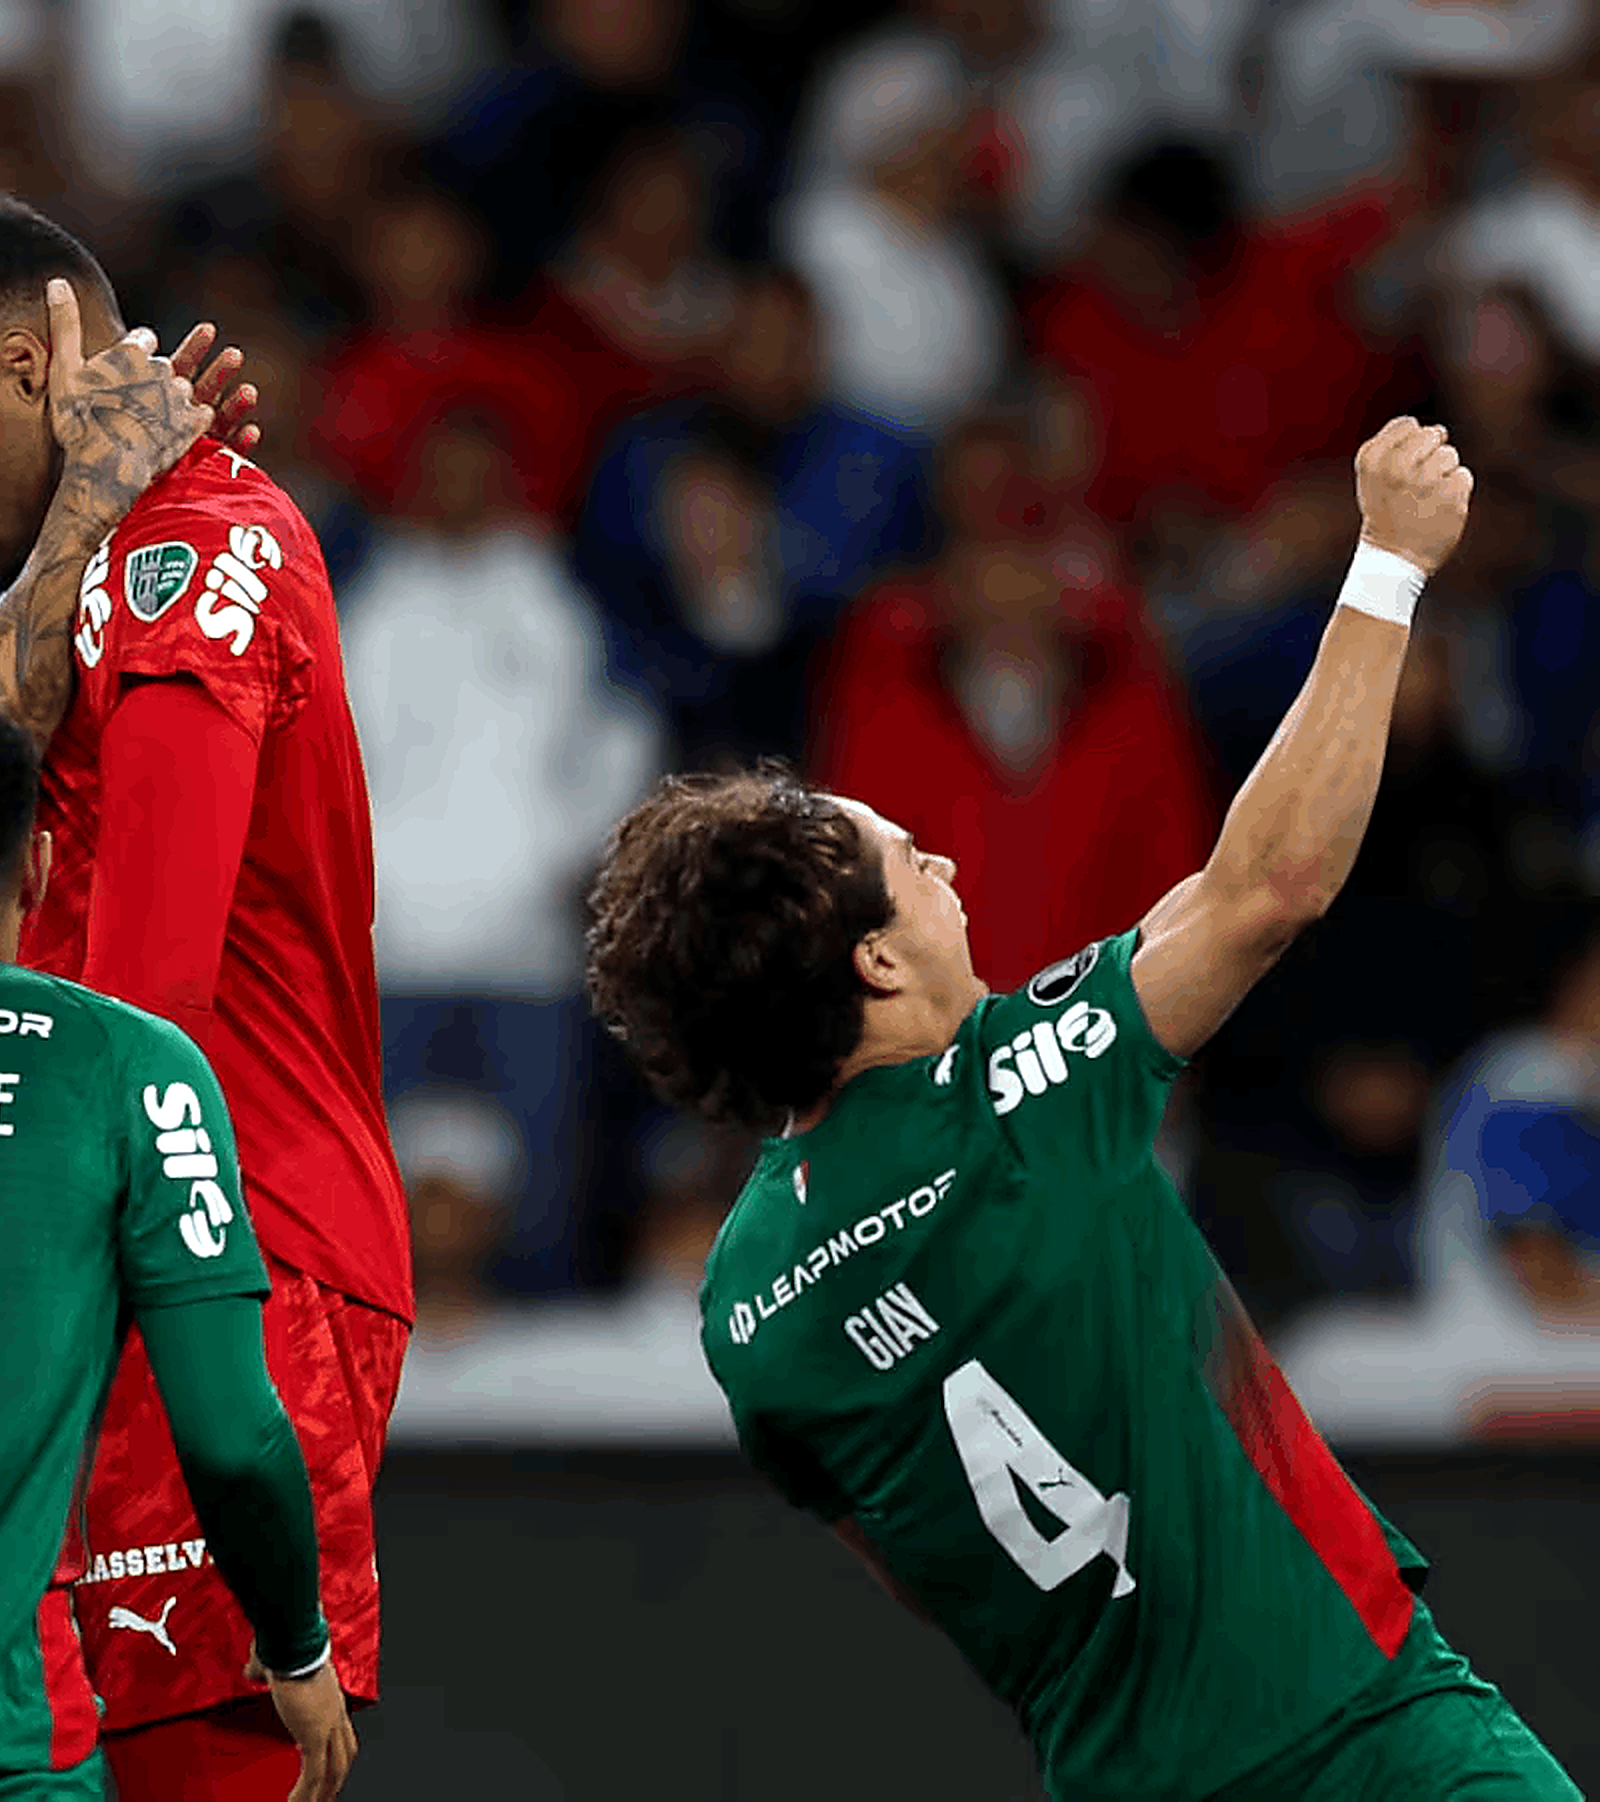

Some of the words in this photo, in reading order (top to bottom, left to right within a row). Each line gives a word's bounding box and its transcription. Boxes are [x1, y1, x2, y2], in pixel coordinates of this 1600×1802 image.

[844, 1282, 940, 1370] GIAY
[943, 1359, 1136, 1599] 4
[80, 1538, 214, 1584] ASSELV
